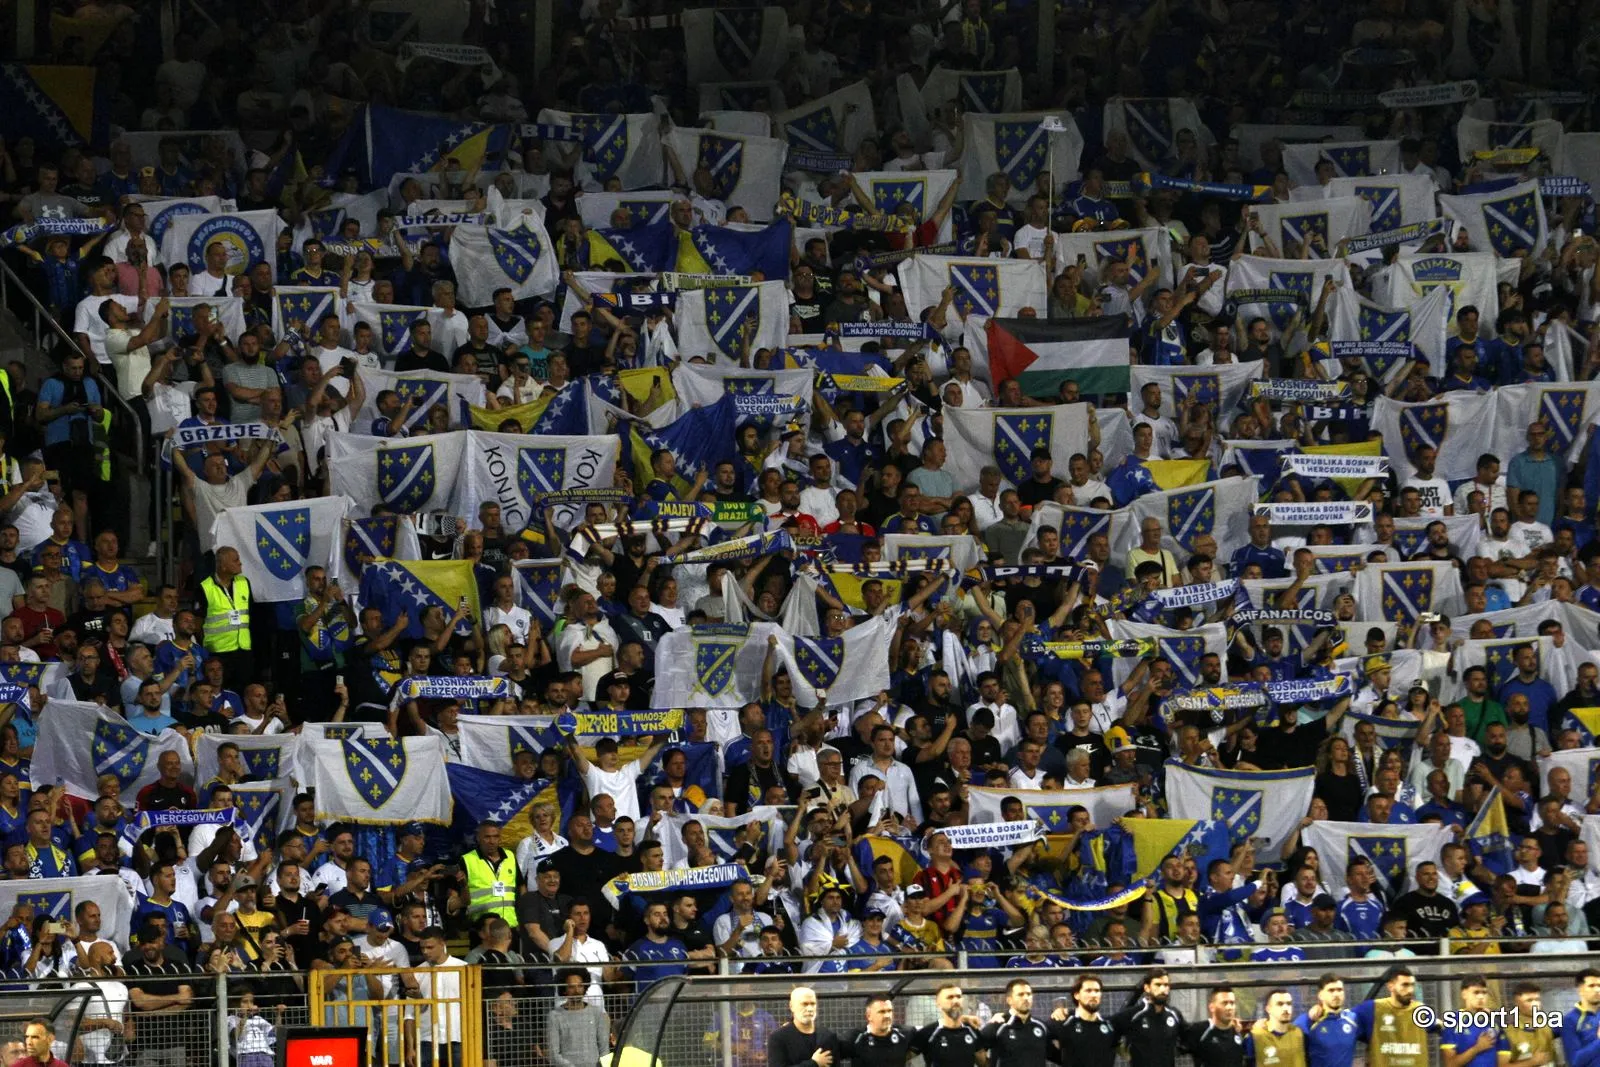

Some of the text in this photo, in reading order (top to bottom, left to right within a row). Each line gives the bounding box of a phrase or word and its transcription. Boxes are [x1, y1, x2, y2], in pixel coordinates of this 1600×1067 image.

[629, 294, 669, 305] BI
[875, 328, 921, 337] HERCEGOVINO
[1272, 380, 1318, 389] BOSNIA&
[1260, 388, 1333, 399] HERZEGOVINA
[180, 424, 261, 442] GAZIJE
[1294, 457, 1375, 467] REPUBLIKA BOSNA
[1306, 466, 1366, 474] HERCEGOVINA
[485, 446, 525, 527] KONJIC
[657, 501, 696, 517] ZMAJEVI
[1275, 504, 1350, 514] REPUBLIKA BOSNA
[718, 510, 748, 521] BRAZIL
[1287, 513, 1343, 521] HERCEGOVINA
[1232, 609, 1333, 624] BHFANATICOS
[430, 678, 474, 687] BOSNIA&
[1268, 680, 1315, 691] BOSNIA&
[419, 686, 488, 696] HERZEGOVINA
[1269, 688, 1330, 701] RZEGOVINA
[155, 811, 226, 824] HERCEGOVINA
[947, 823, 1029, 837] EPUBLIKA BOSNA
[956, 834, 1021, 845] HERCEGOVINA
[632, 864, 738, 888] BOSNIA AND HERZEGOVINA
[1416, 905, 1451, 919] POLO
[309, 1055, 334, 1066] VAR
